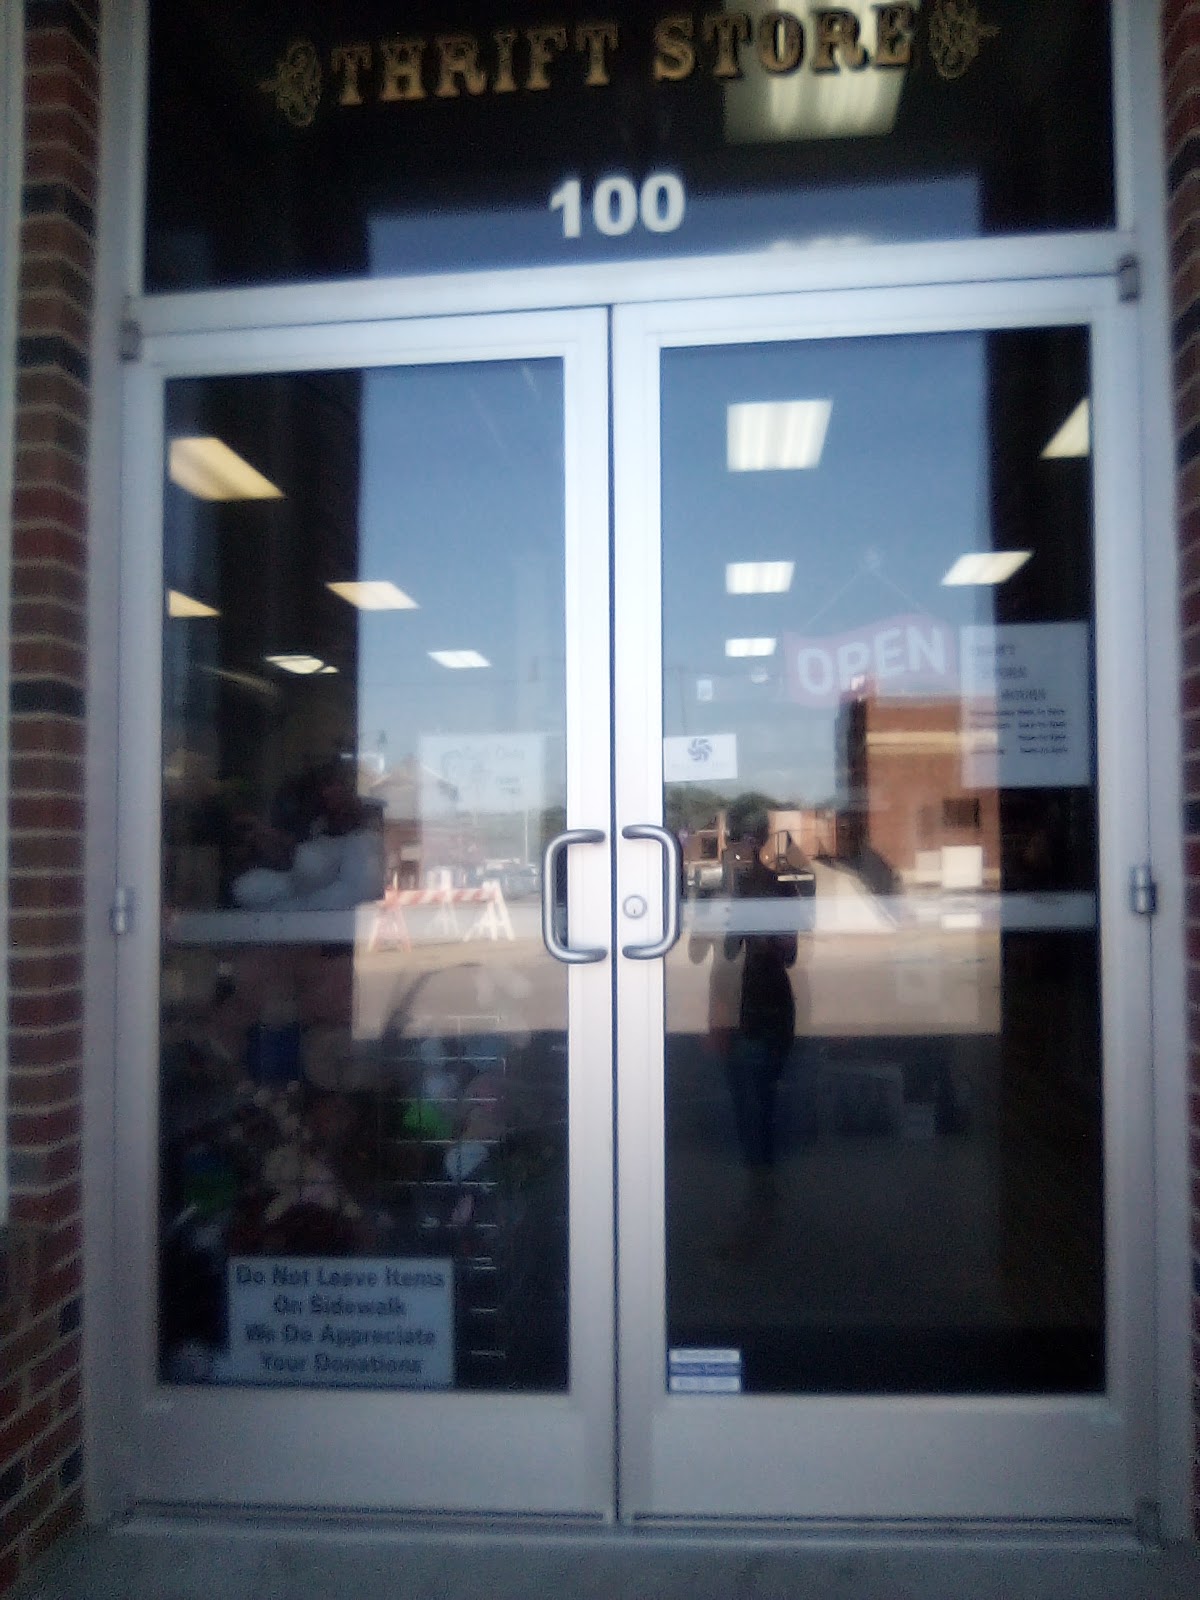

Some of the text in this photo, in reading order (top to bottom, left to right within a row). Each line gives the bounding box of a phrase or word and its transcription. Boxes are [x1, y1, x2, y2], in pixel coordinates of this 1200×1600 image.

[330, 1, 913, 106] THRIFT STORE
[550, 173, 686, 239] 100
[797, 624, 948, 696] OPEN
[235, 1262, 446, 1288] Do Not Leave Items
[273, 1292, 408, 1316] On Sidewalk
[319, 1322, 437, 1348] Appreciate
[258, 1351, 424, 1375] Your Donations
